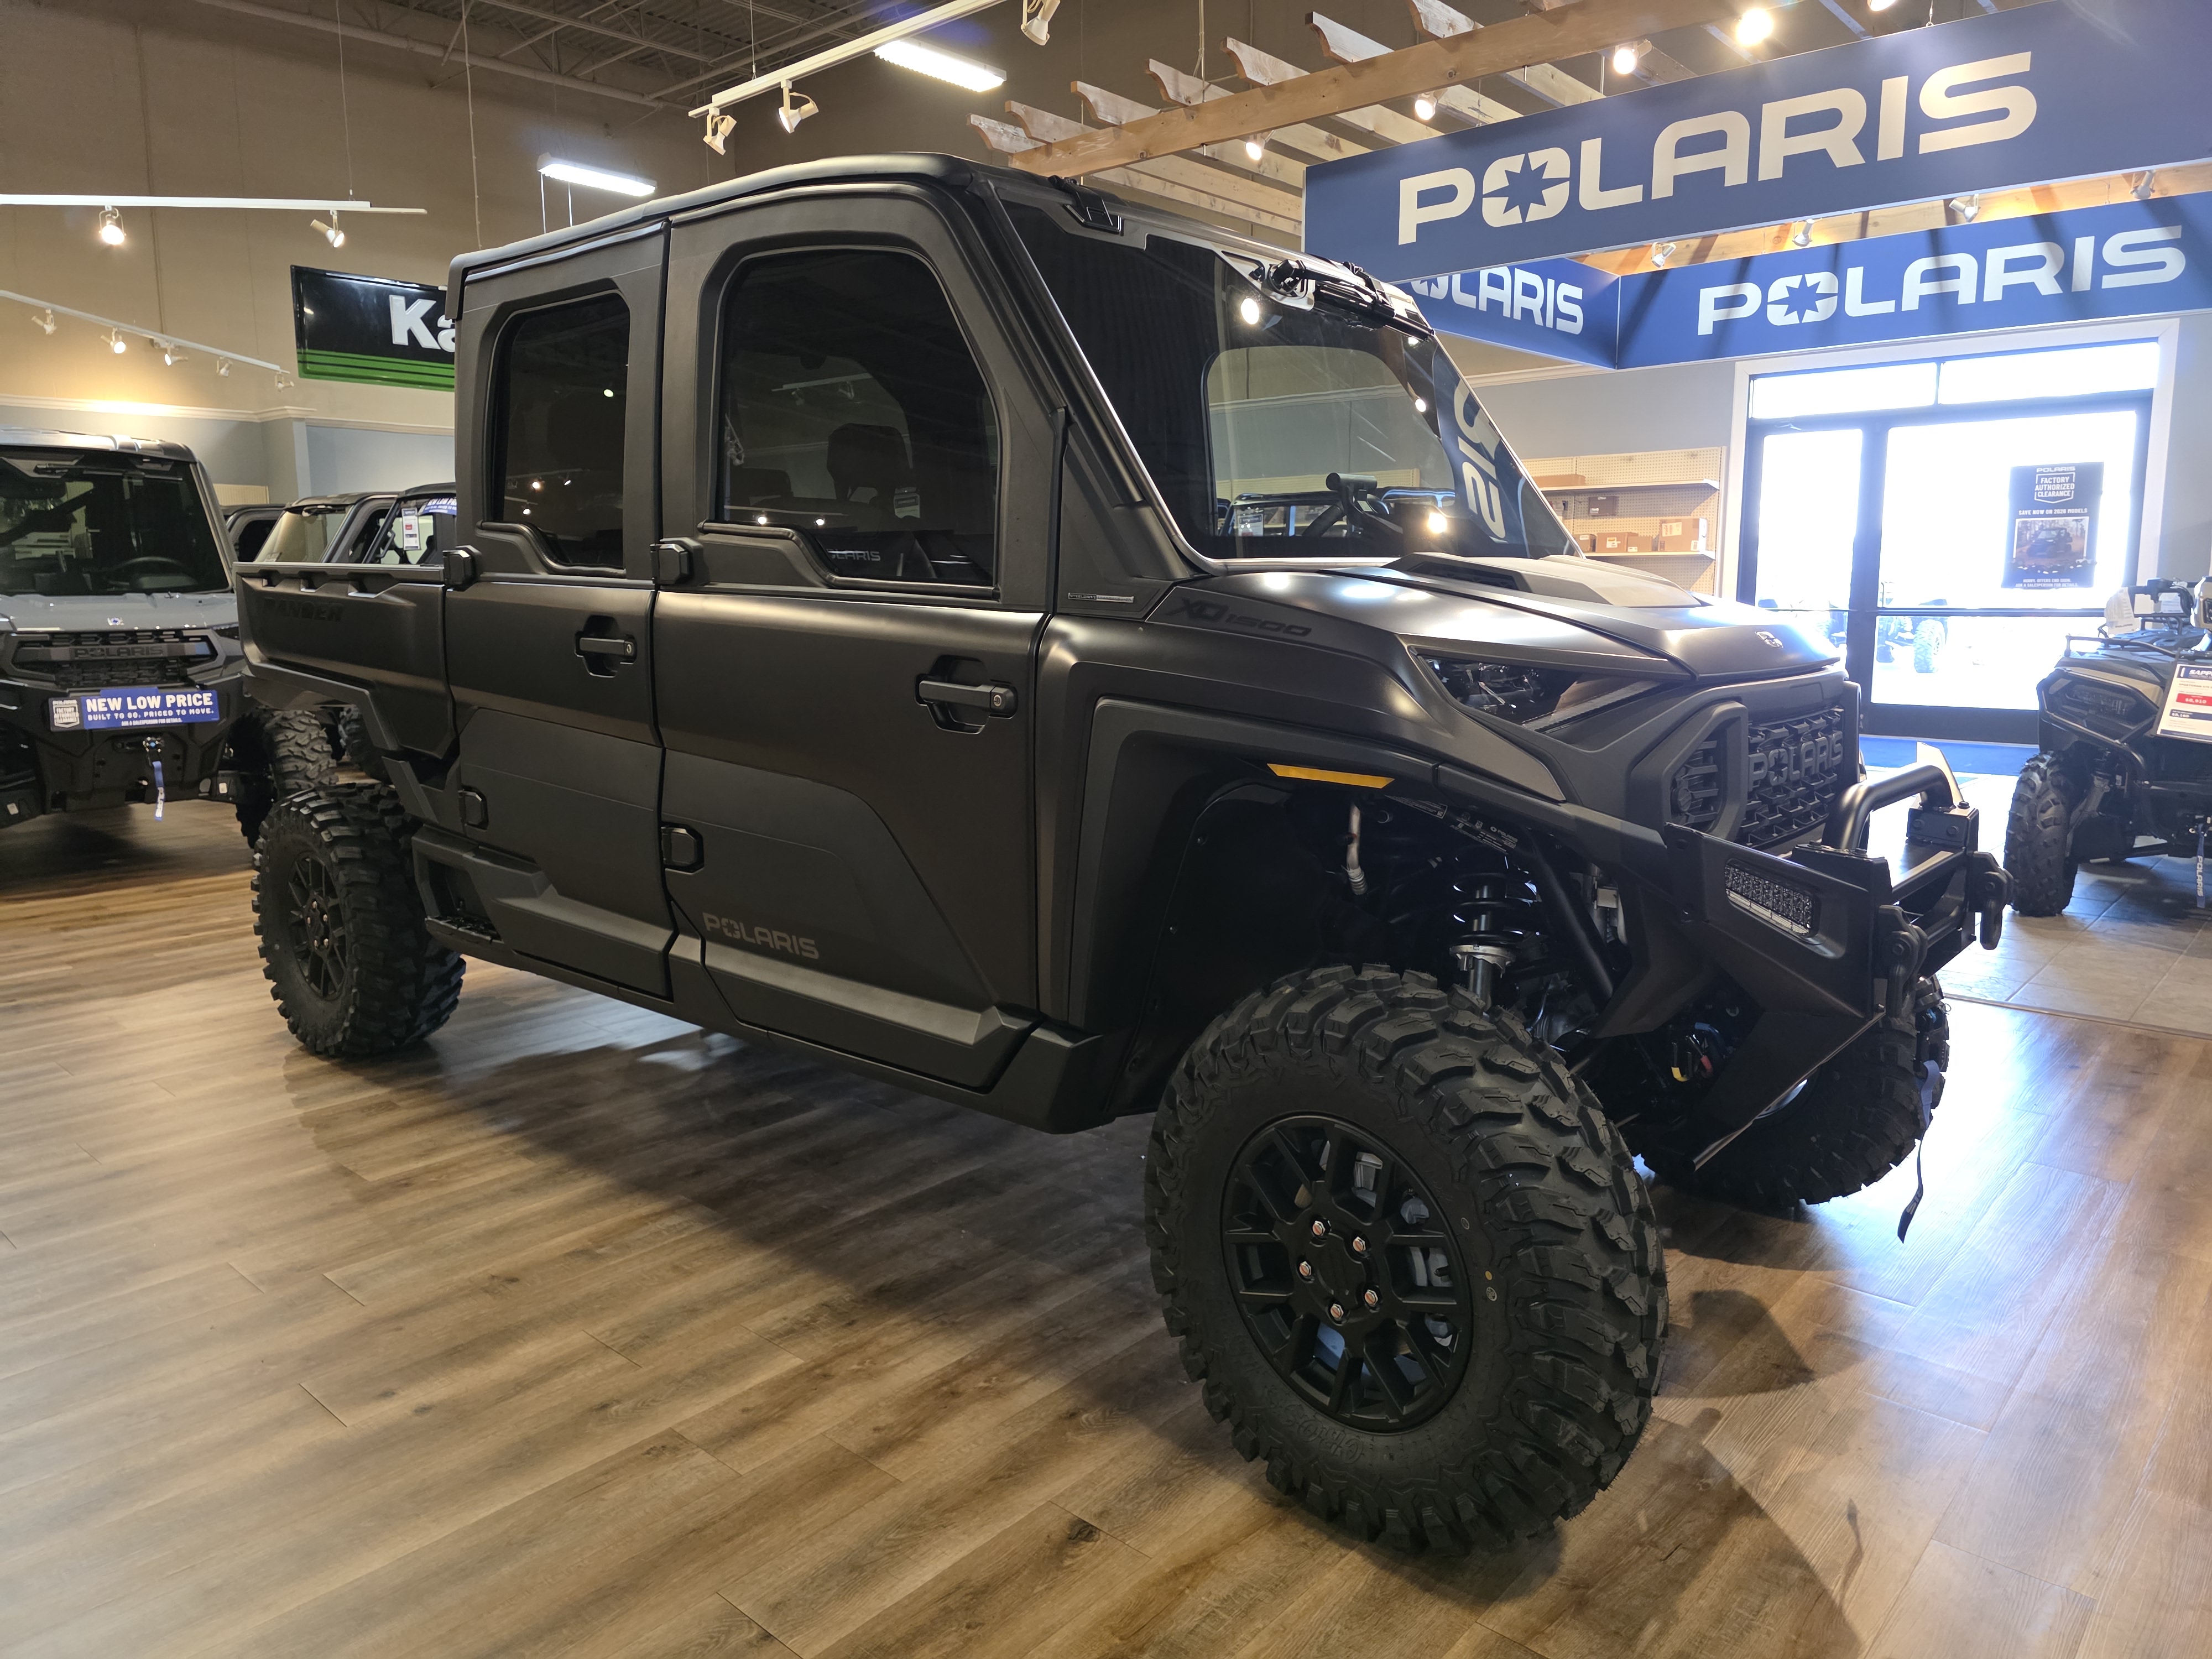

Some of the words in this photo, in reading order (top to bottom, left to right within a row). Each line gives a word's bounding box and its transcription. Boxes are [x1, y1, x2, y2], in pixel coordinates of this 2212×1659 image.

[1398, 51, 2037, 246] POLARIS
[1697, 225, 2187, 336] POLARIS
[1225, 613, 1312, 637] 1500
[74, 646, 164, 660] POLARIS
[86, 697, 122, 712] NEW
[127, 695, 161, 710] LOW
[166, 692, 213, 708] PRICE
[144, 709, 174, 718] PRICED
[1748, 731, 1843, 792] POLARIS
[702, 912, 820, 959] POLARIS
